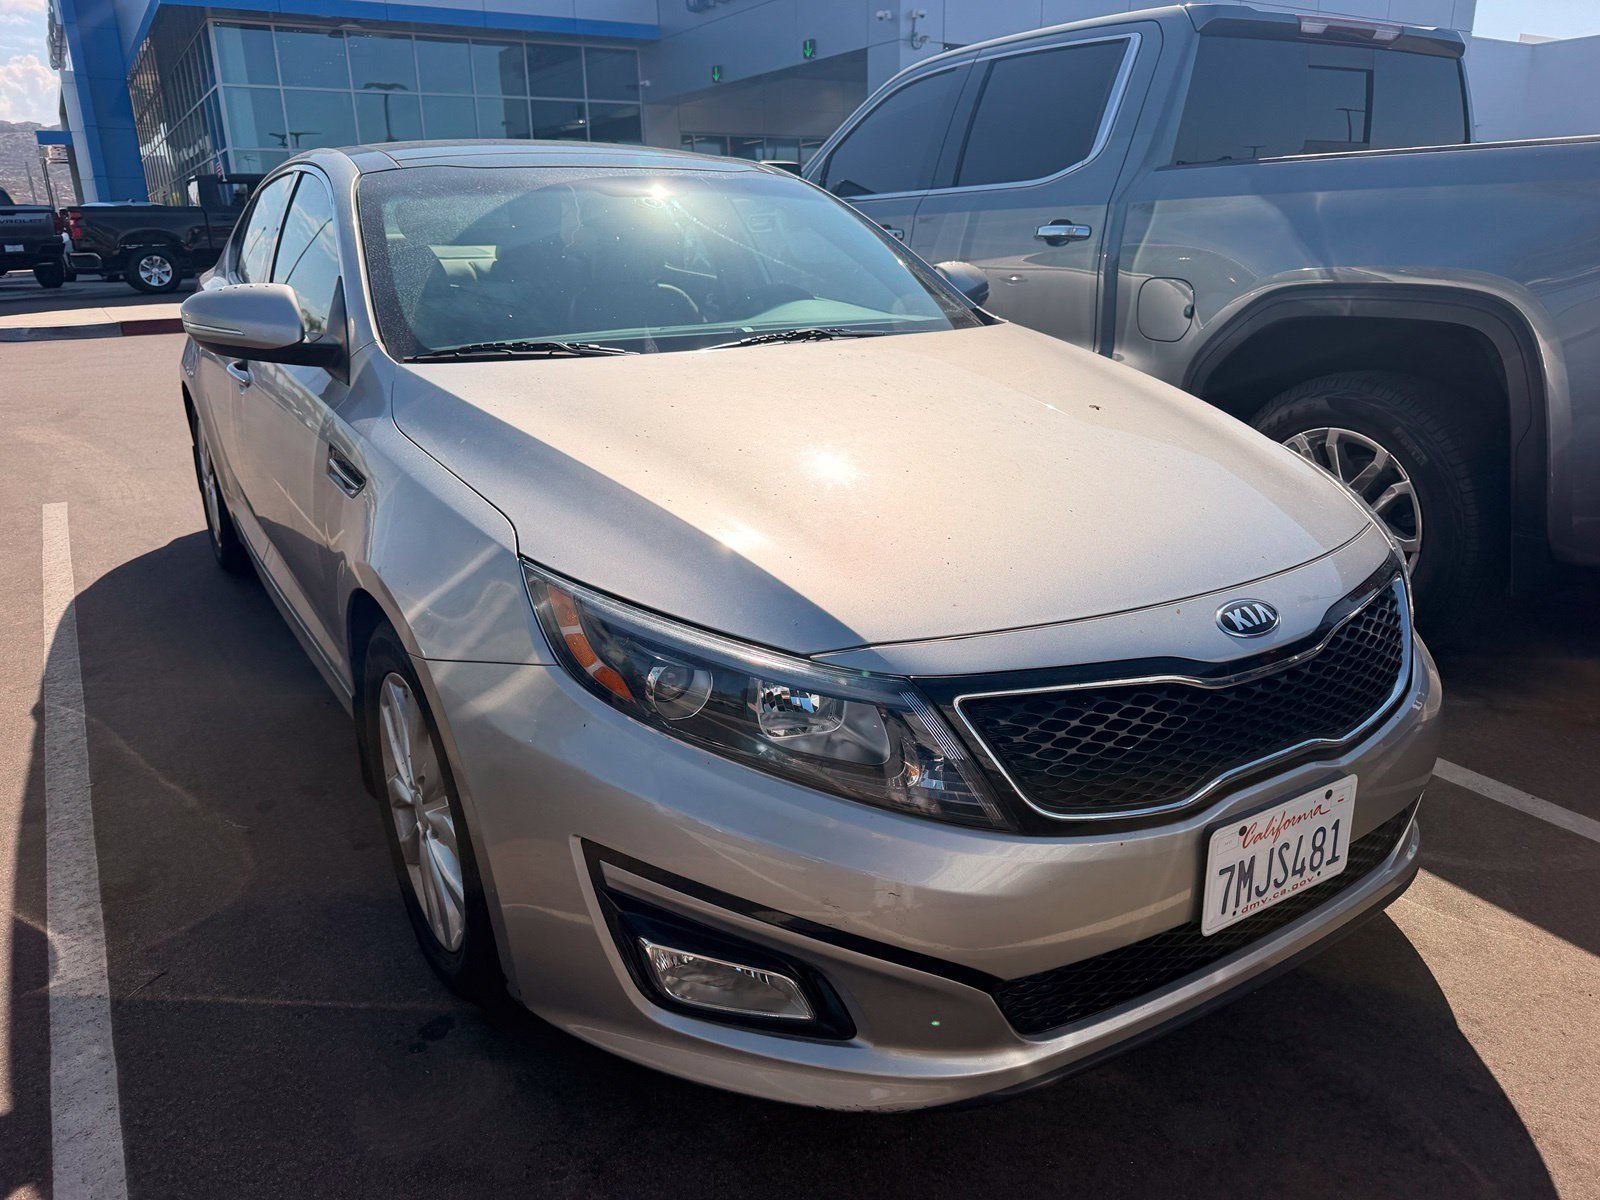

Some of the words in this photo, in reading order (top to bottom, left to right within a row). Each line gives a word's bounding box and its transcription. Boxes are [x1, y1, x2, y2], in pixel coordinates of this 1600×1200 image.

[1224, 603, 1275, 631] KIA
[1242, 801, 1330, 849] California
[1218, 818, 1341, 915] 7MJS481
[1241, 876, 1314, 914] dmv.ca.gov
